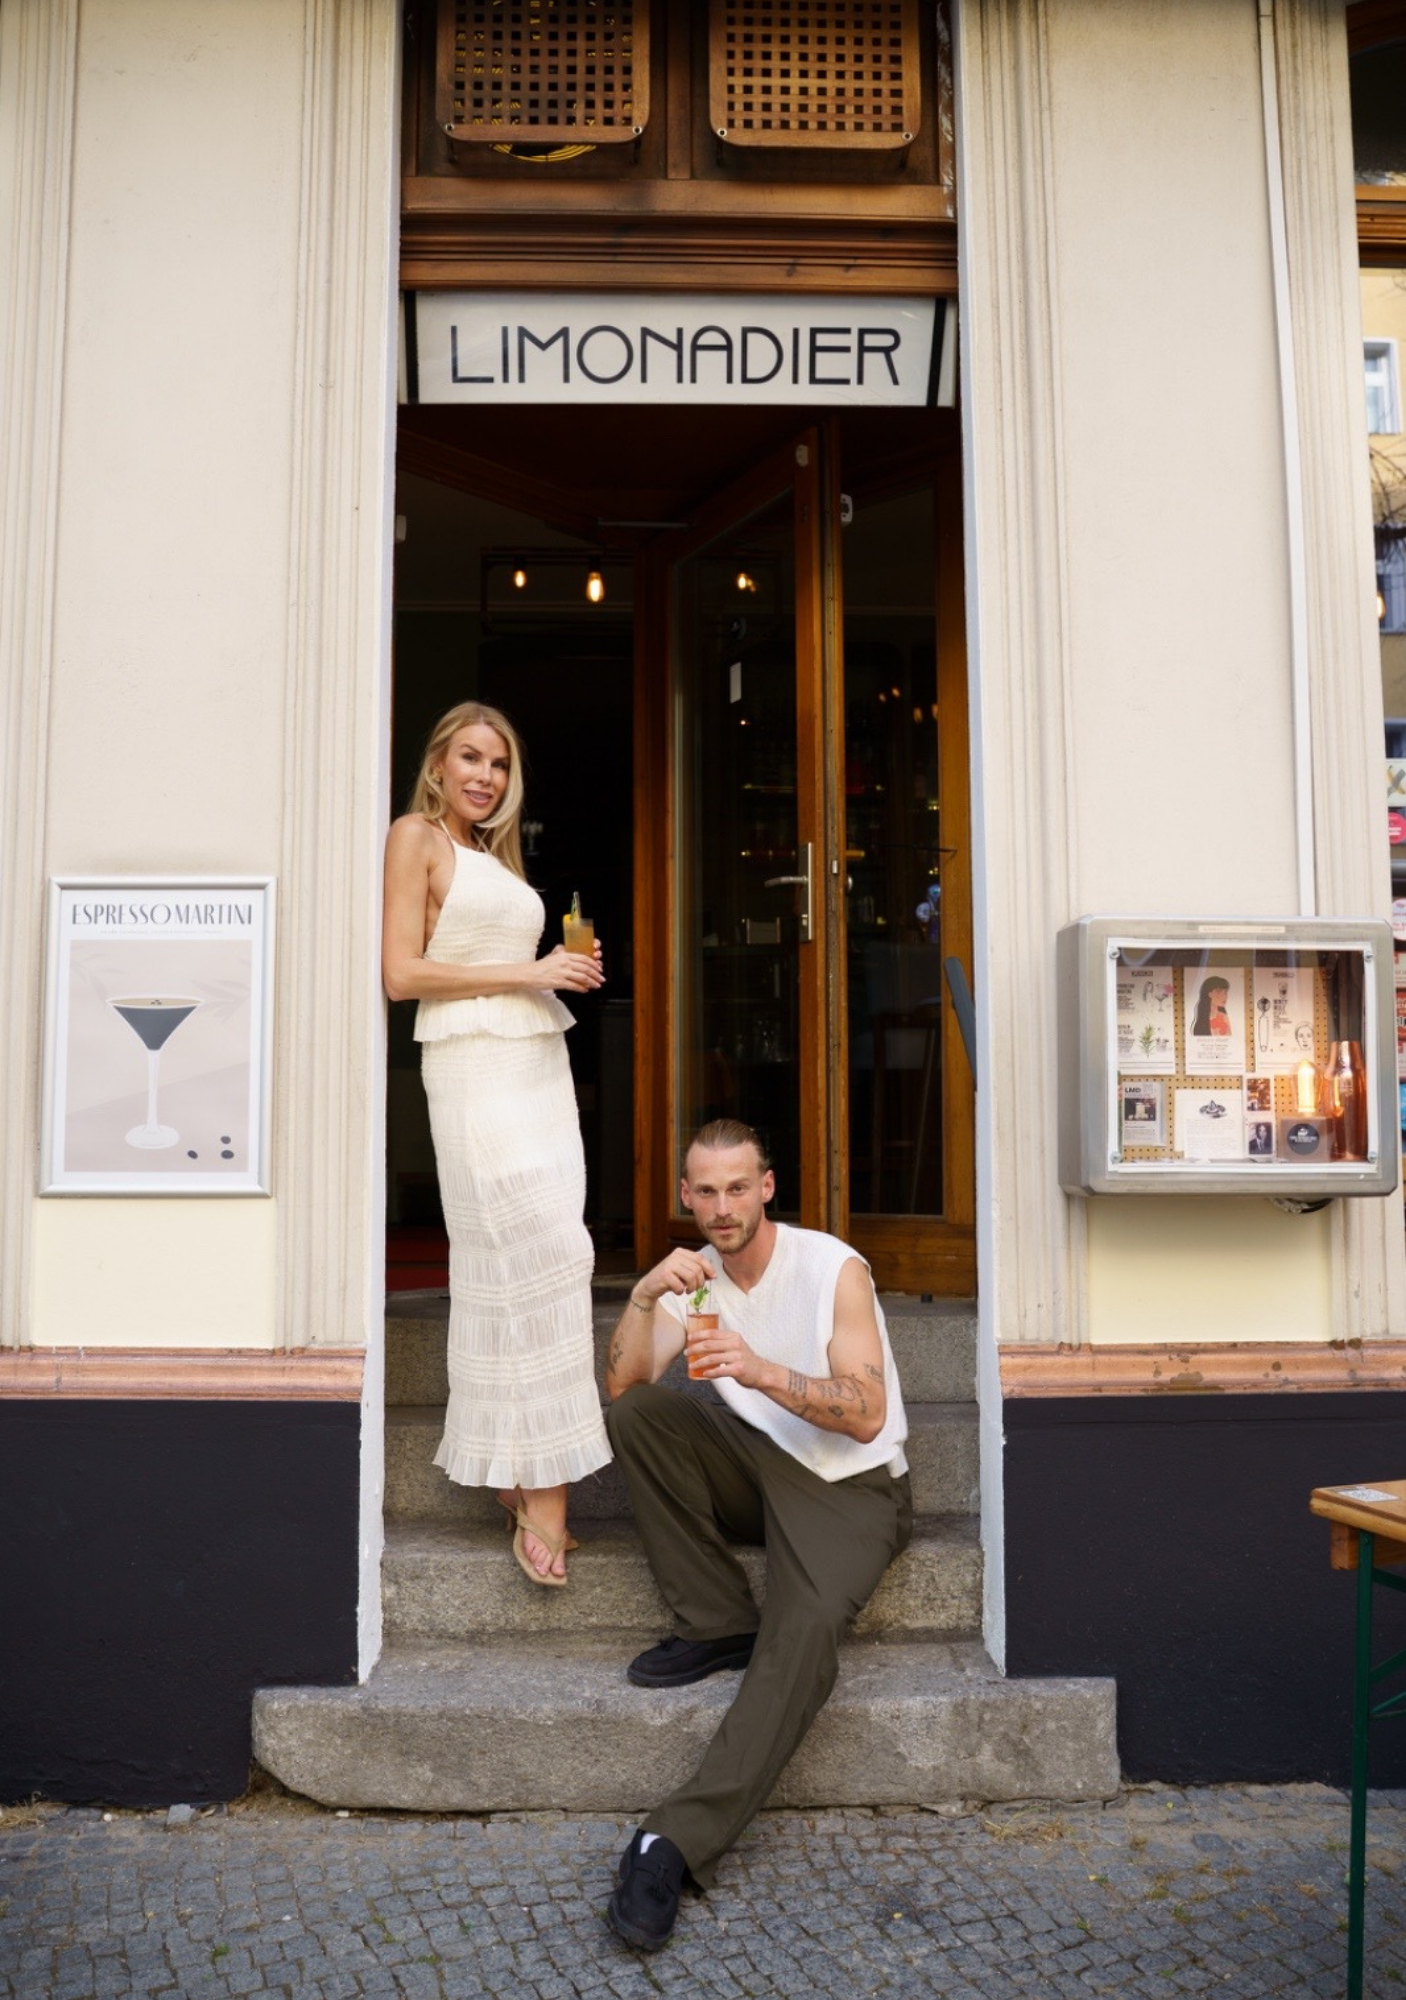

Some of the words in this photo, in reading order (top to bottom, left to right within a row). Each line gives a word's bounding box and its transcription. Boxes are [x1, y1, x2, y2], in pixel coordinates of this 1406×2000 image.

[450, 324, 900, 386] LIMONADIER
[72, 904, 171, 925] ESPRESSO
[174, 904, 253, 925] MARTINI
